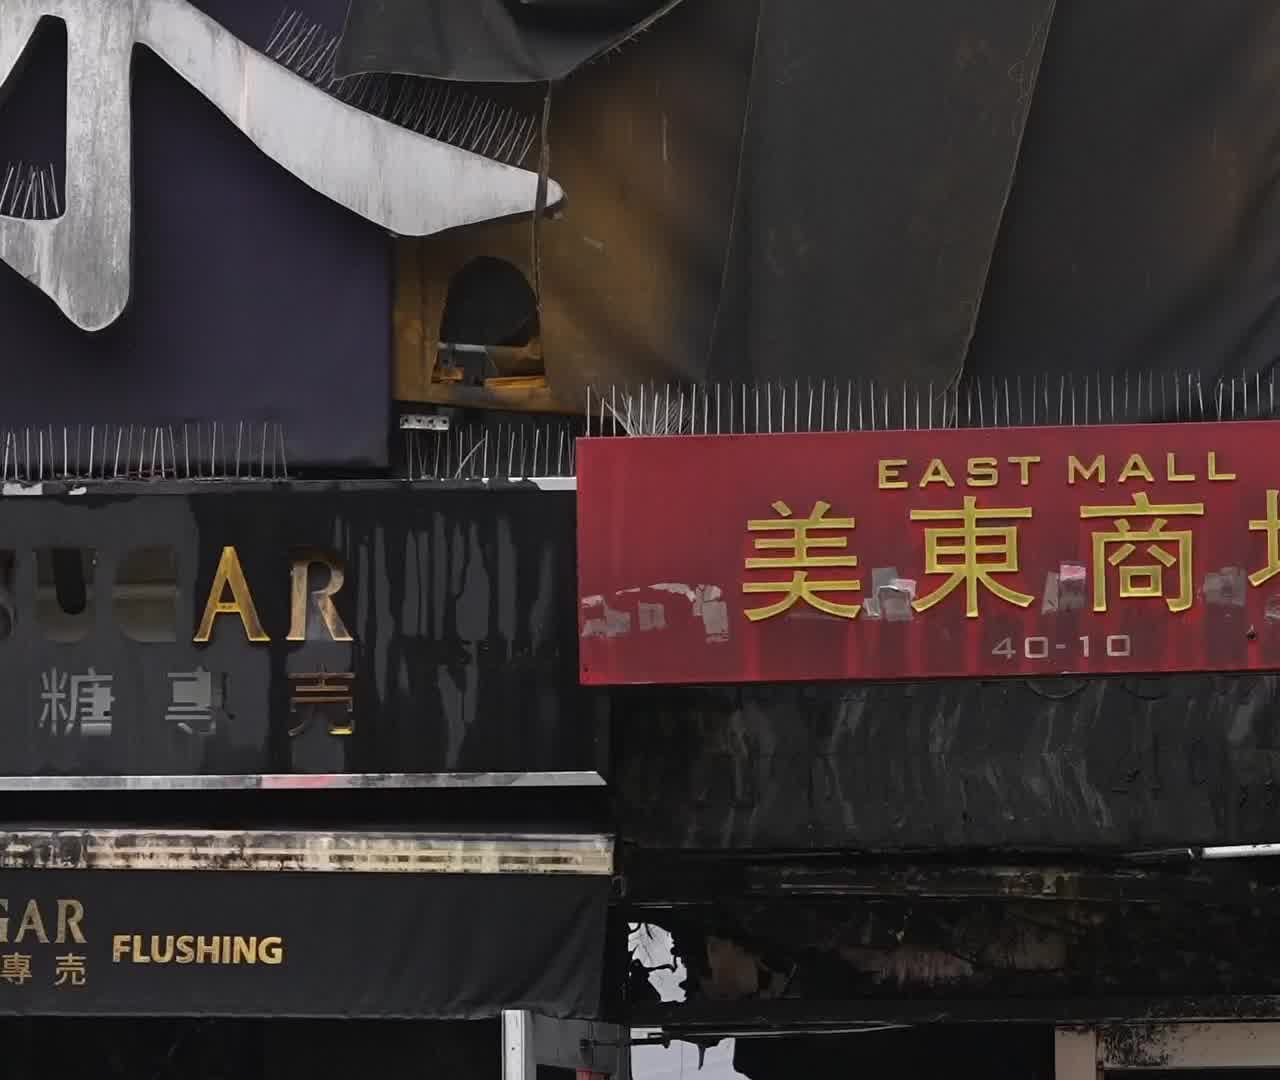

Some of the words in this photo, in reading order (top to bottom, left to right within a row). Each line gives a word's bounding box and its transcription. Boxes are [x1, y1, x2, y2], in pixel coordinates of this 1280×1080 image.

[877, 456, 1041, 489] EAST
[1067, 451, 1237, 484] MALL
[991, 634, 1131, 660] 40-10
[112, 935, 283, 965] FLUSHING
